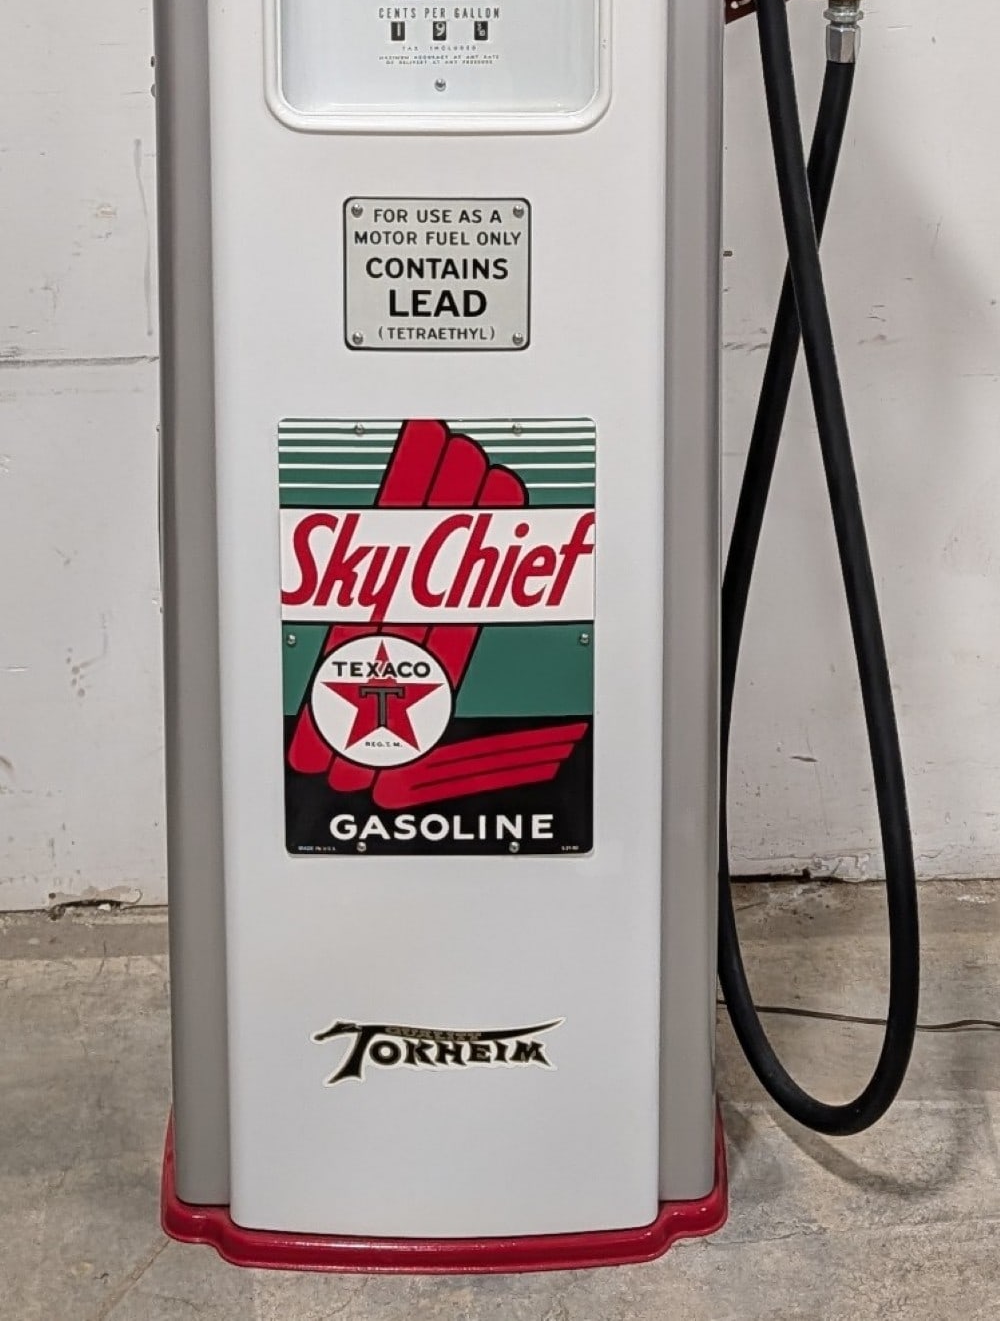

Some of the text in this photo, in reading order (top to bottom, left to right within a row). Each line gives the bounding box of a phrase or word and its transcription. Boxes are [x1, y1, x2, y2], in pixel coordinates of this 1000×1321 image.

[378, 7, 500, 19] CENTS PER GALLON
[373, 209, 502, 224] FOR USE AS A
[354, 231, 522, 246] MOTOR FUEL ONLY
[365, 257, 509, 280] CONTAINS
[389, 289, 487, 318] LEAD
[280, 512, 595, 622] Sky Chief
[332, 660, 431, 679] TEXACO
[359, 684, 406, 728] T
[329, 813, 555, 841] GASOLINE
[313, 1020, 565, 1084] TOKHEIM
